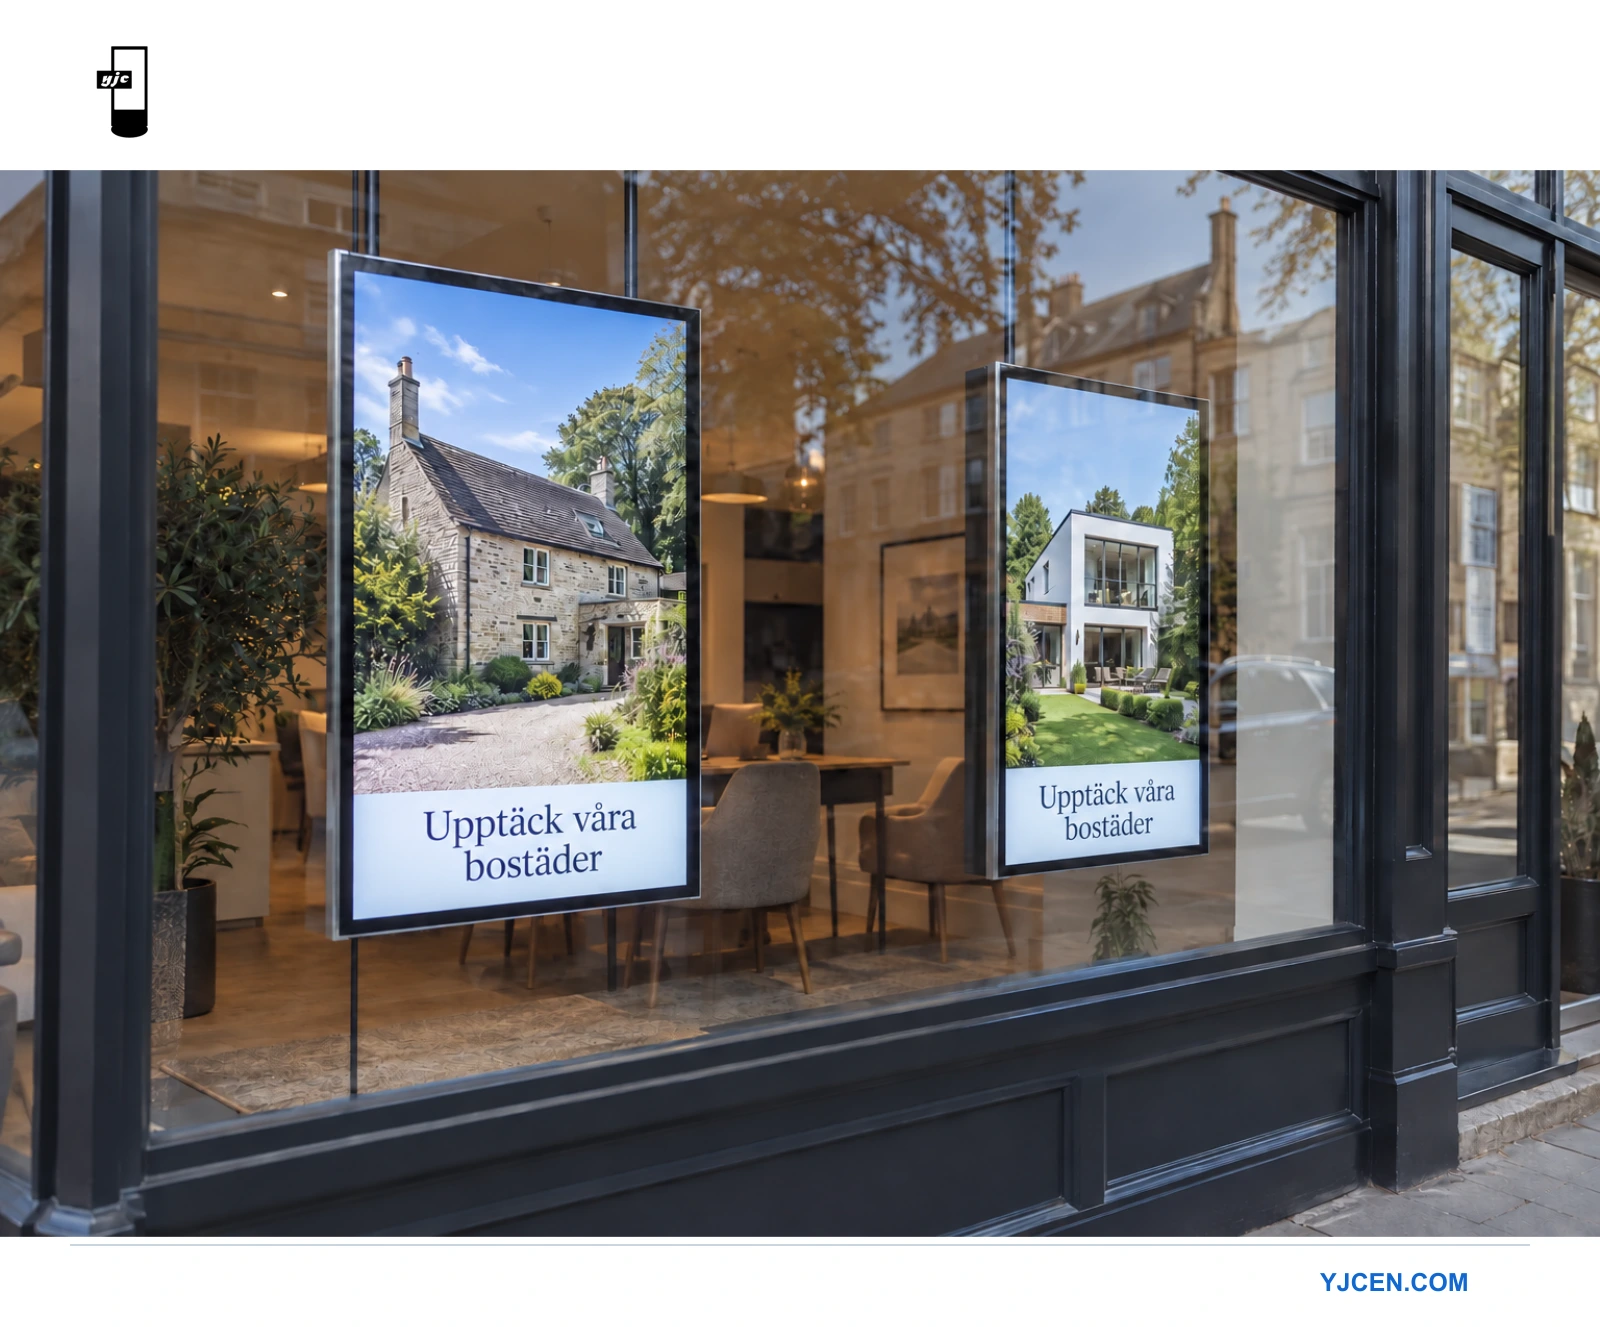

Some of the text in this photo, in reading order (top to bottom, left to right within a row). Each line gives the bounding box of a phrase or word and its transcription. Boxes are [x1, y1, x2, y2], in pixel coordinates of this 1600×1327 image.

[1039, 778, 1175, 814] Upptäck våra
[424, 803, 637, 848] Upptäck våra
[1065, 812, 1154, 840] bostäder
[465, 844, 603, 881] bostäder
